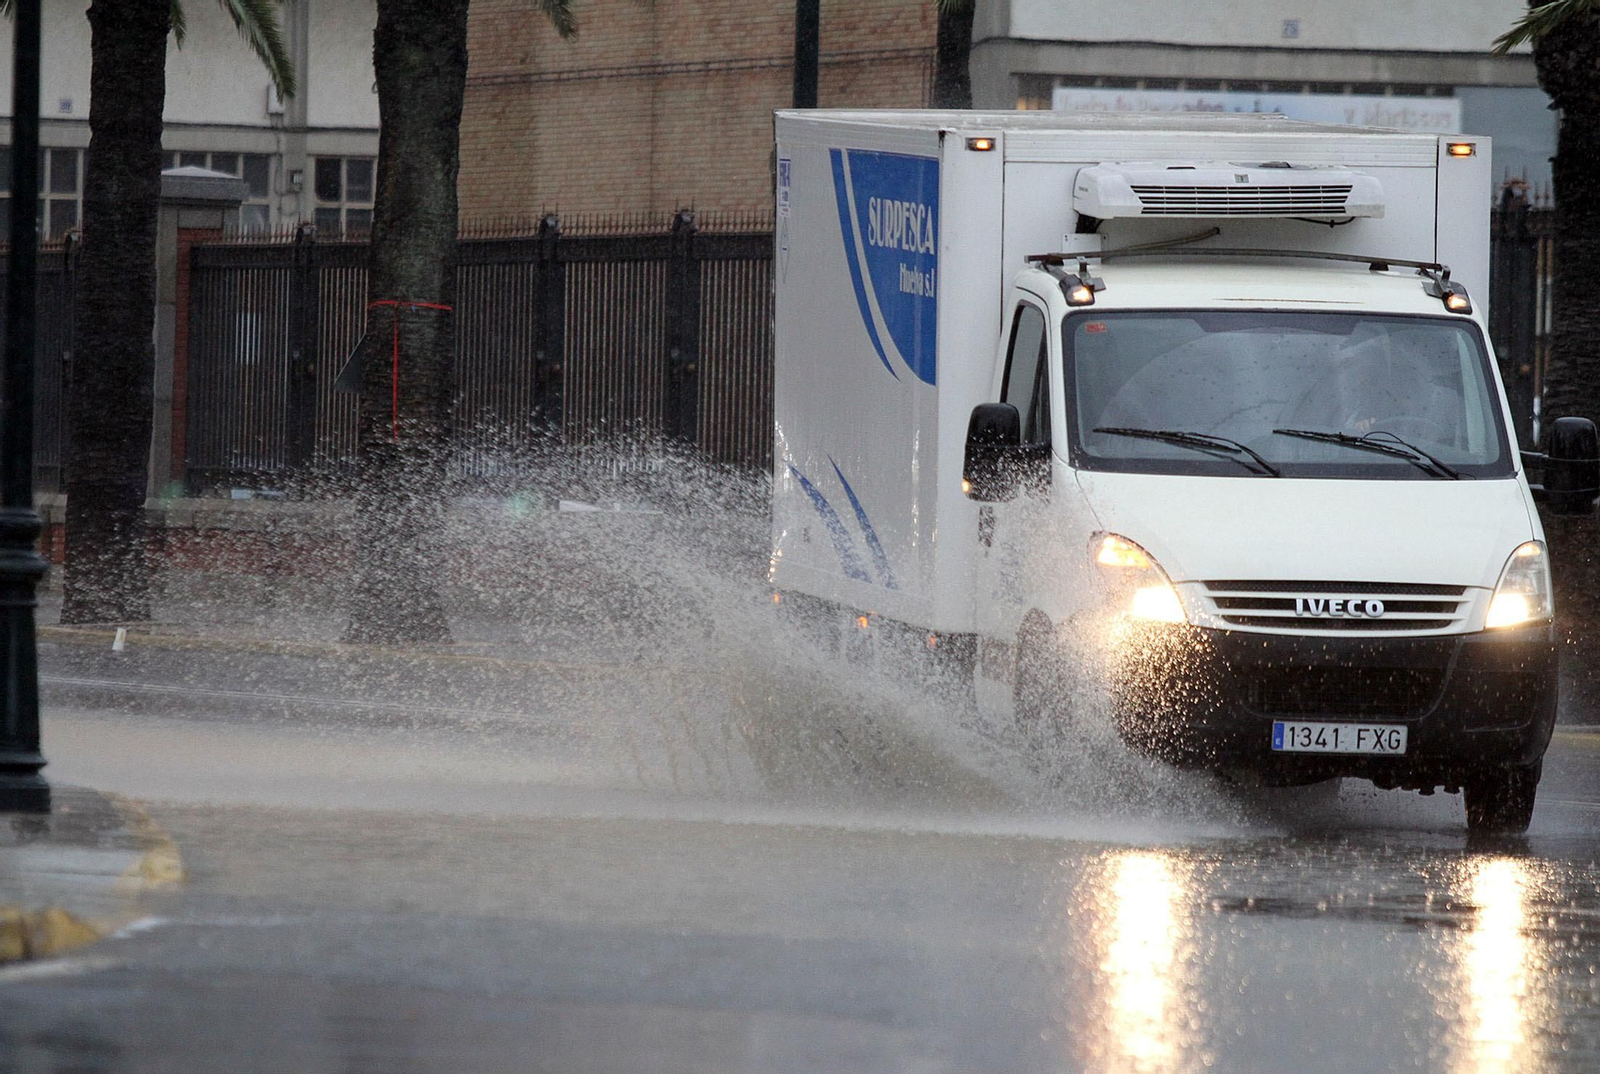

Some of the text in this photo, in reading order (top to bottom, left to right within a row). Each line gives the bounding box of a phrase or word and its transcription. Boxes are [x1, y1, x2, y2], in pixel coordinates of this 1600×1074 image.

[868, 196, 935, 255] SURPESCA
[1295, 598, 1385, 617] IVECO
[1289, 726, 1339, 749] 1341
[1356, 728, 1401, 750] FXG
